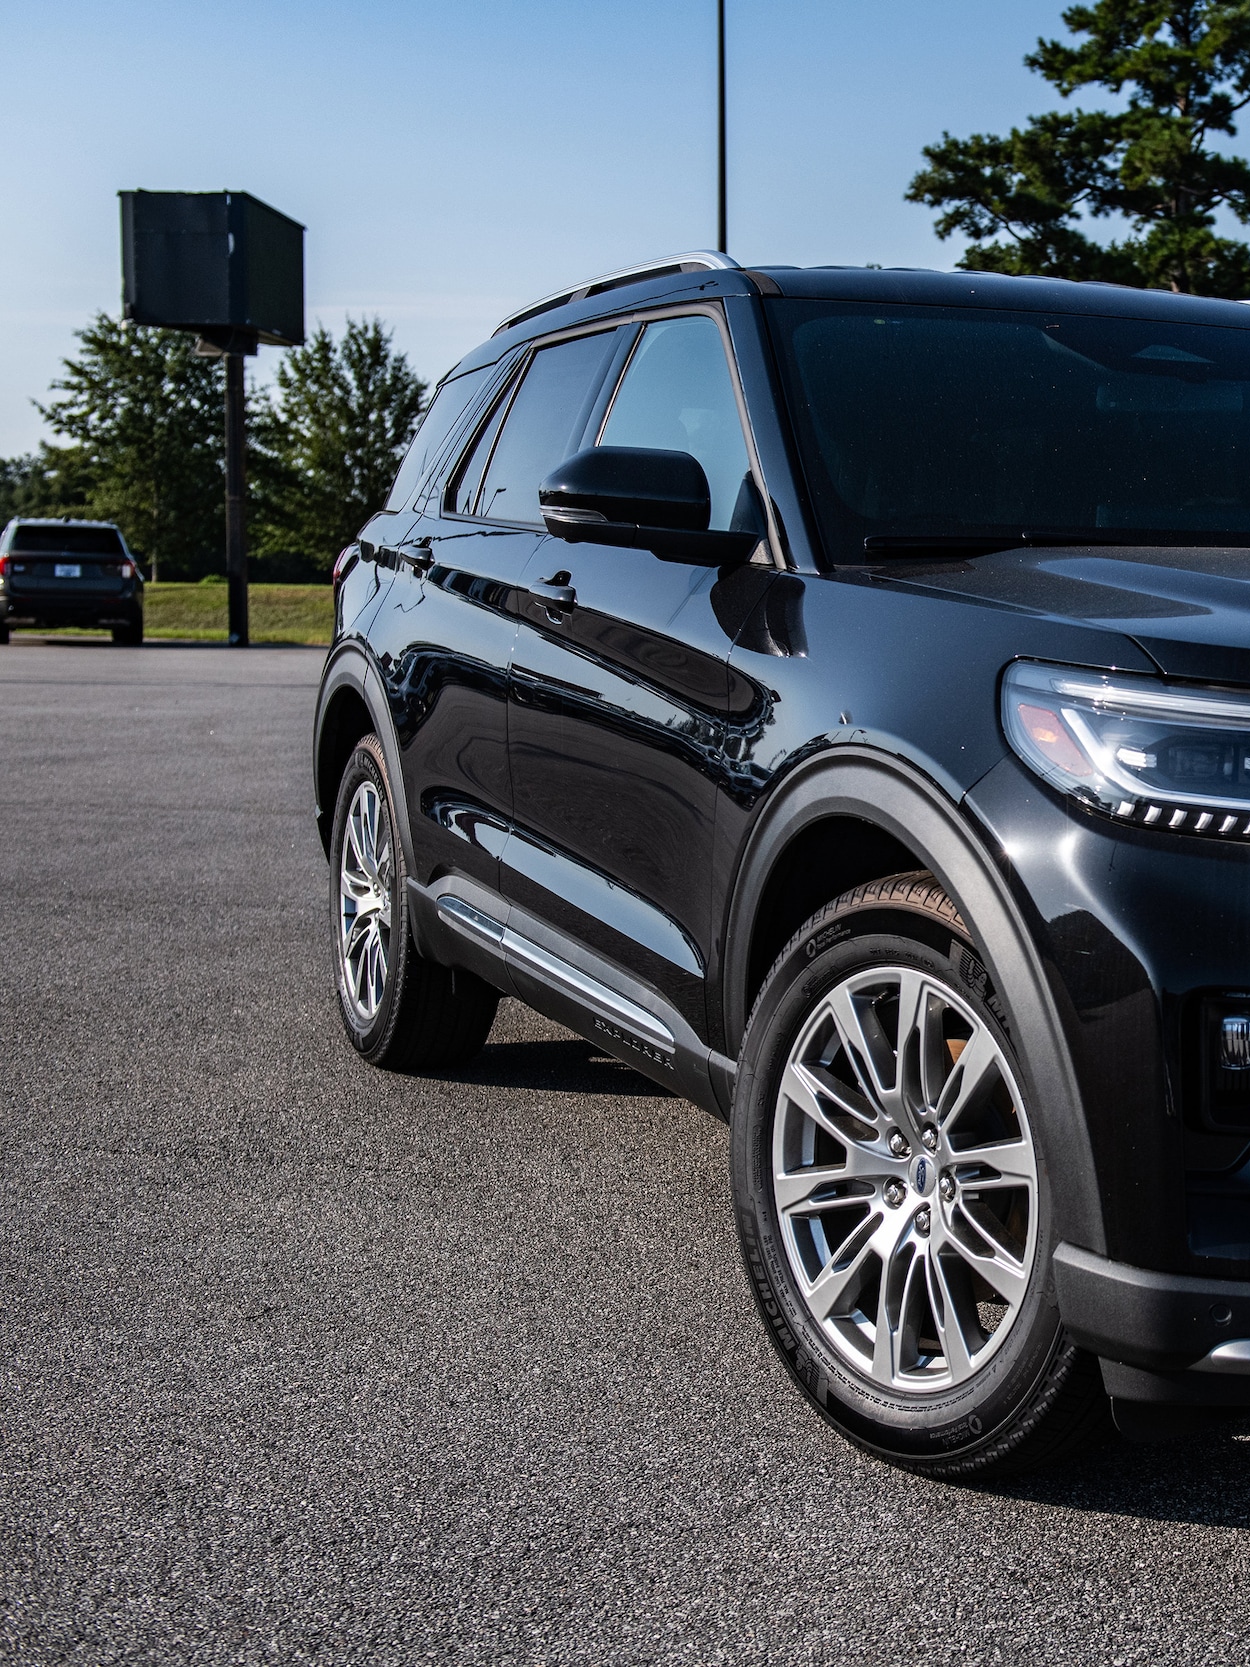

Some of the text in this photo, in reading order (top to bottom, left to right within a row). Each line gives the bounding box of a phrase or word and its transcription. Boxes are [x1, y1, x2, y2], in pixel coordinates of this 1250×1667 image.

[363, 756, 384, 800] MICHELIN
[593, 1017, 675, 1071] EXPLORER
[741, 1213, 797, 1351] MICHELIN
